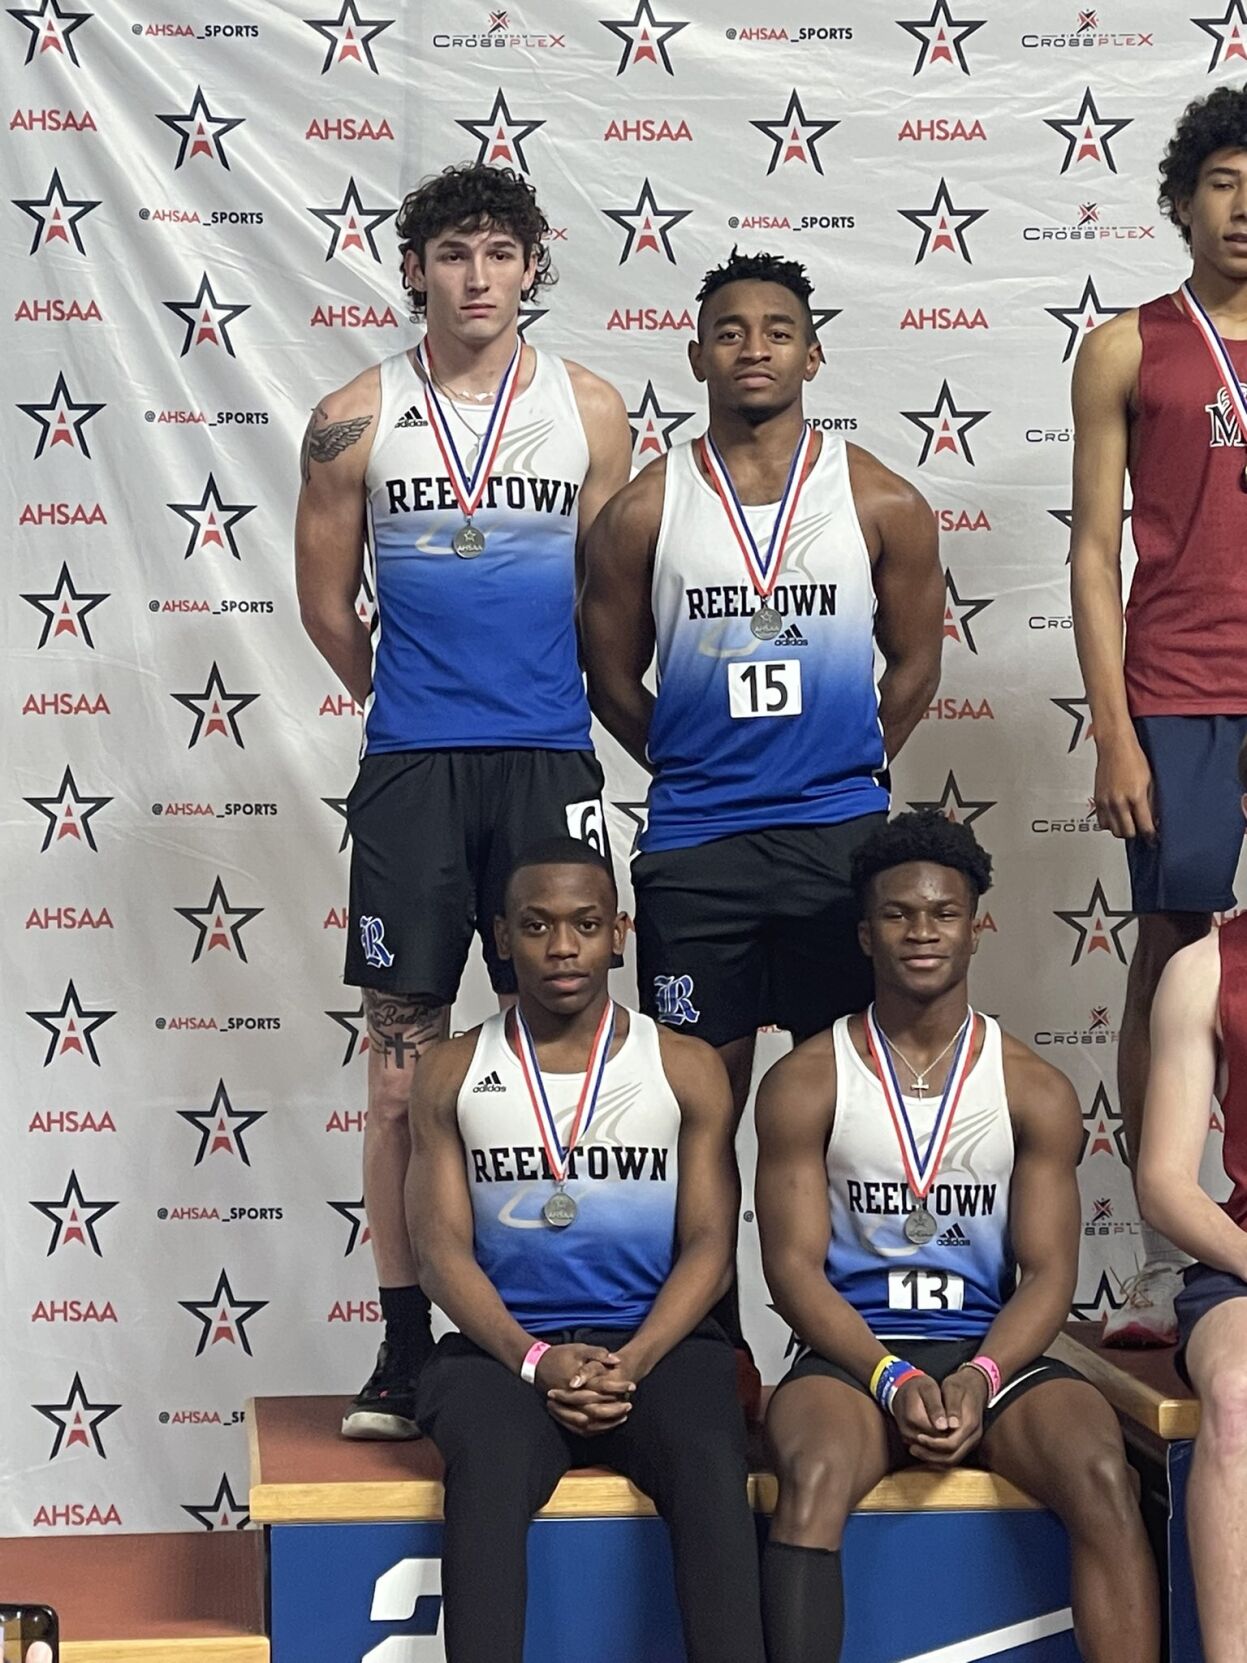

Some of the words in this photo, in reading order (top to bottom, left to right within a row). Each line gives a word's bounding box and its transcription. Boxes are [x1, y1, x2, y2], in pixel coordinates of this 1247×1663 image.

[10, 110, 97, 132] AHSAA
[305, 118, 394, 141] AHSAA
[604, 119, 693, 142] AHSAA
[897, 119, 987, 142] AHSAA
[15, 299, 103, 322] AHSAA
[310, 305, 398, 328] AHSAA
[607, 308, 696, 331] AHSAA
[900, 307, 989, 330] AHSAA
[386, 476, 579, 517] REETOWN
[19, 503, 107, 526] AHSAA
[686, 584, 838, 620] REELOWN
[740, 663, 789, 713] 15
[22, 692, 110, 715] AHSAA
[922, 698, 995, 720] HSAA
[26, 907, 114, 929] AHSAA
[472, 1083, 507, 1093] adidas
[29, 1111, 116, 1133] AHSAA
[847, 1180, 997, 1218] REELOWN
[901, 1269, 949, 1310] 13
[31, 1300, 118, 1323] AHSAA
[328, 1300, 382, 1323] AHS
[33, 1503, 122, 1527] AHSAA
